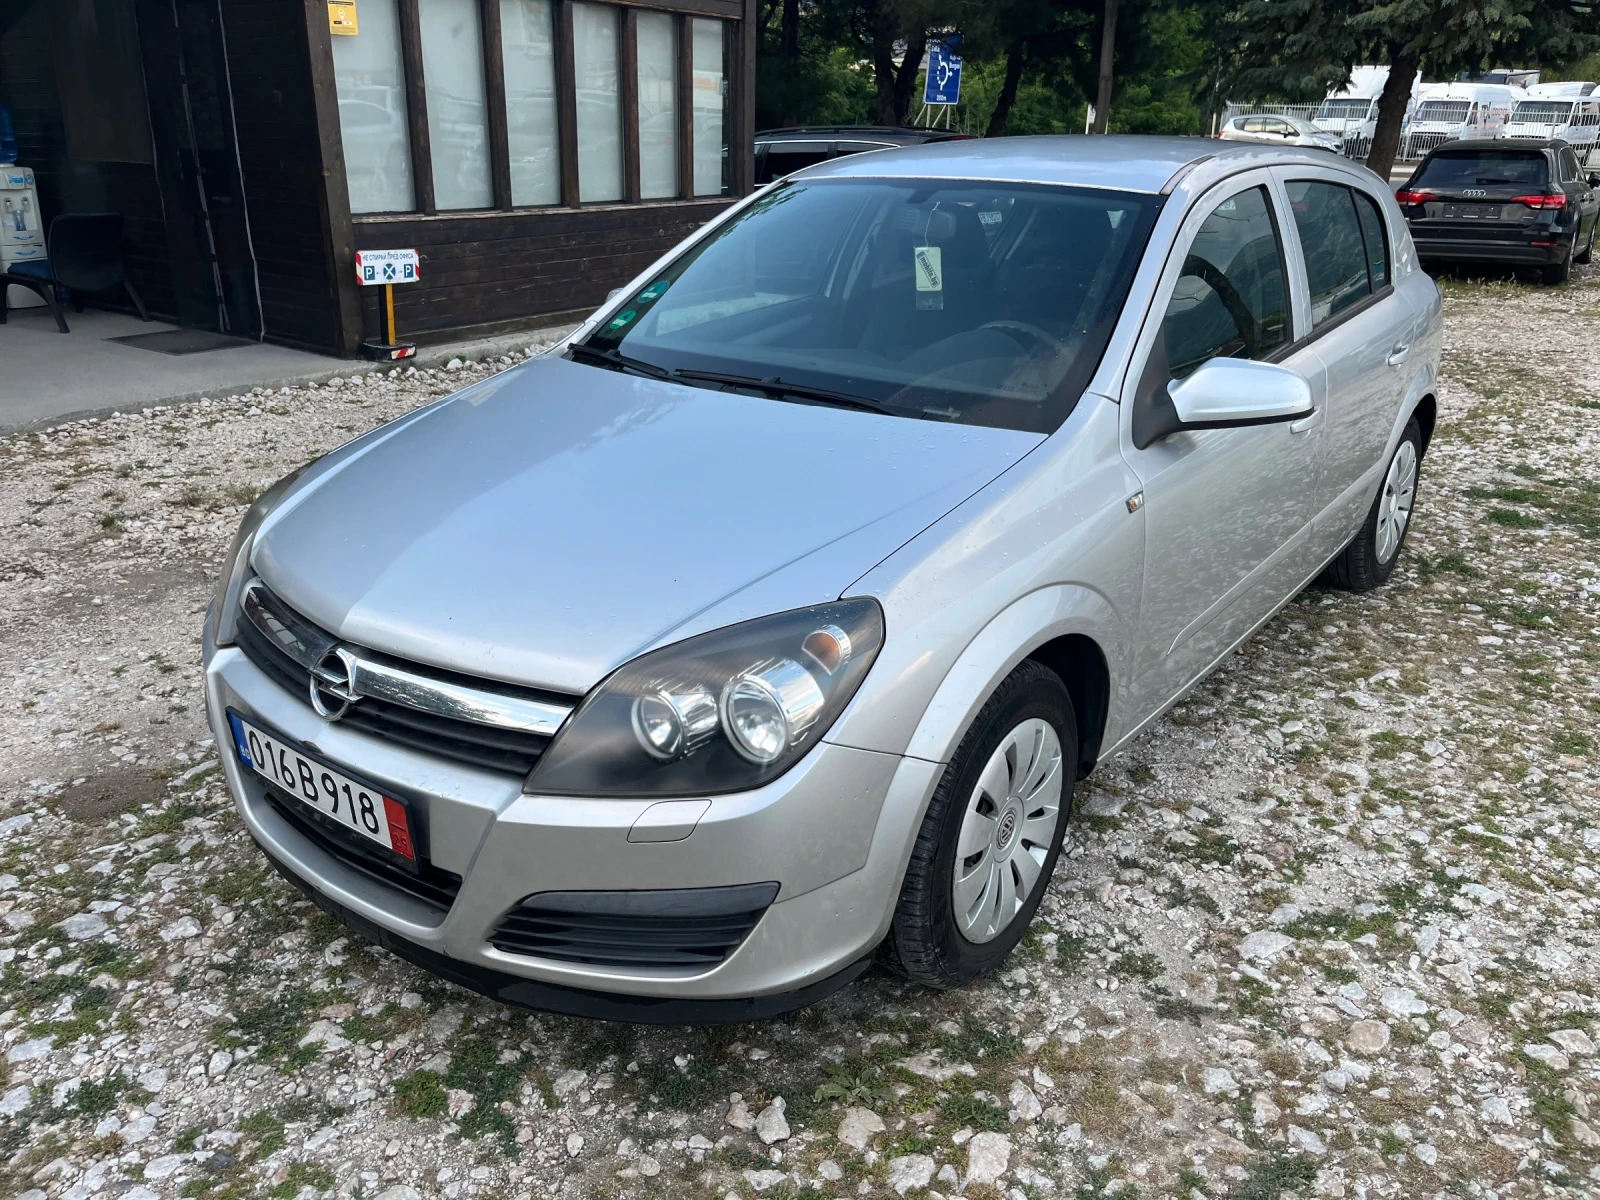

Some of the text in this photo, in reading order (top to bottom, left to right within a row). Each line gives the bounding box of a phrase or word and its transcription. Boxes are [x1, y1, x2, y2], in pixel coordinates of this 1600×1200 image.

[366, 267, 372, 279] P
[406, 265, 412, 276] P
[919, 256, 938, 287] mobile.bg
[248, 730, 380, 835] 016B918
